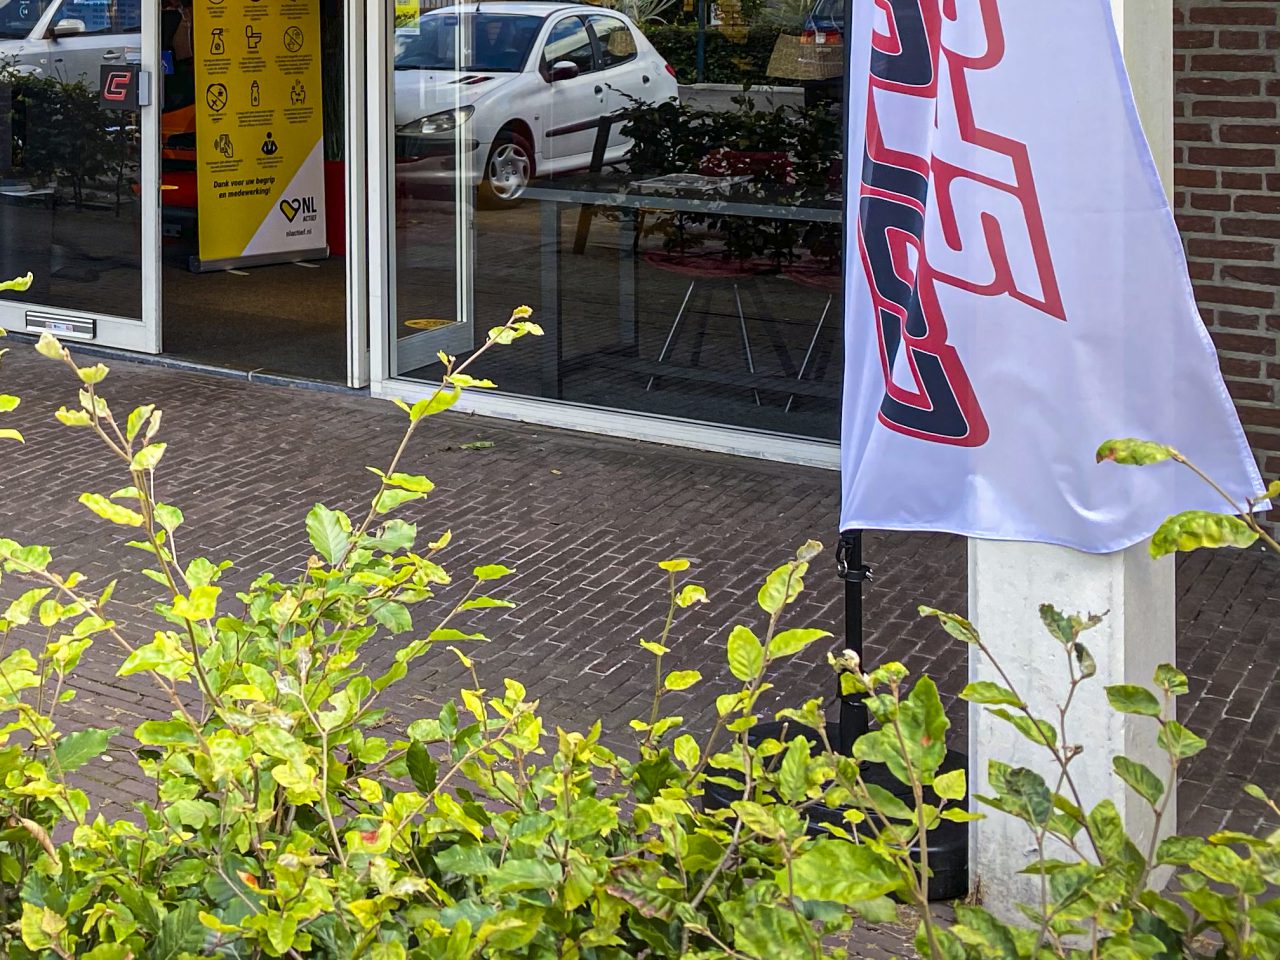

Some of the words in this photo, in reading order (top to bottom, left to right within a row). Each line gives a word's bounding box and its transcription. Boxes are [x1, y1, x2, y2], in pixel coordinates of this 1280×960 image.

[213, 180, 229, 188] Dank
[256, 176, 276, 186] begrip
[227, 187, 271, 198] medewerking!
[302, 196, 317, 214] NL
